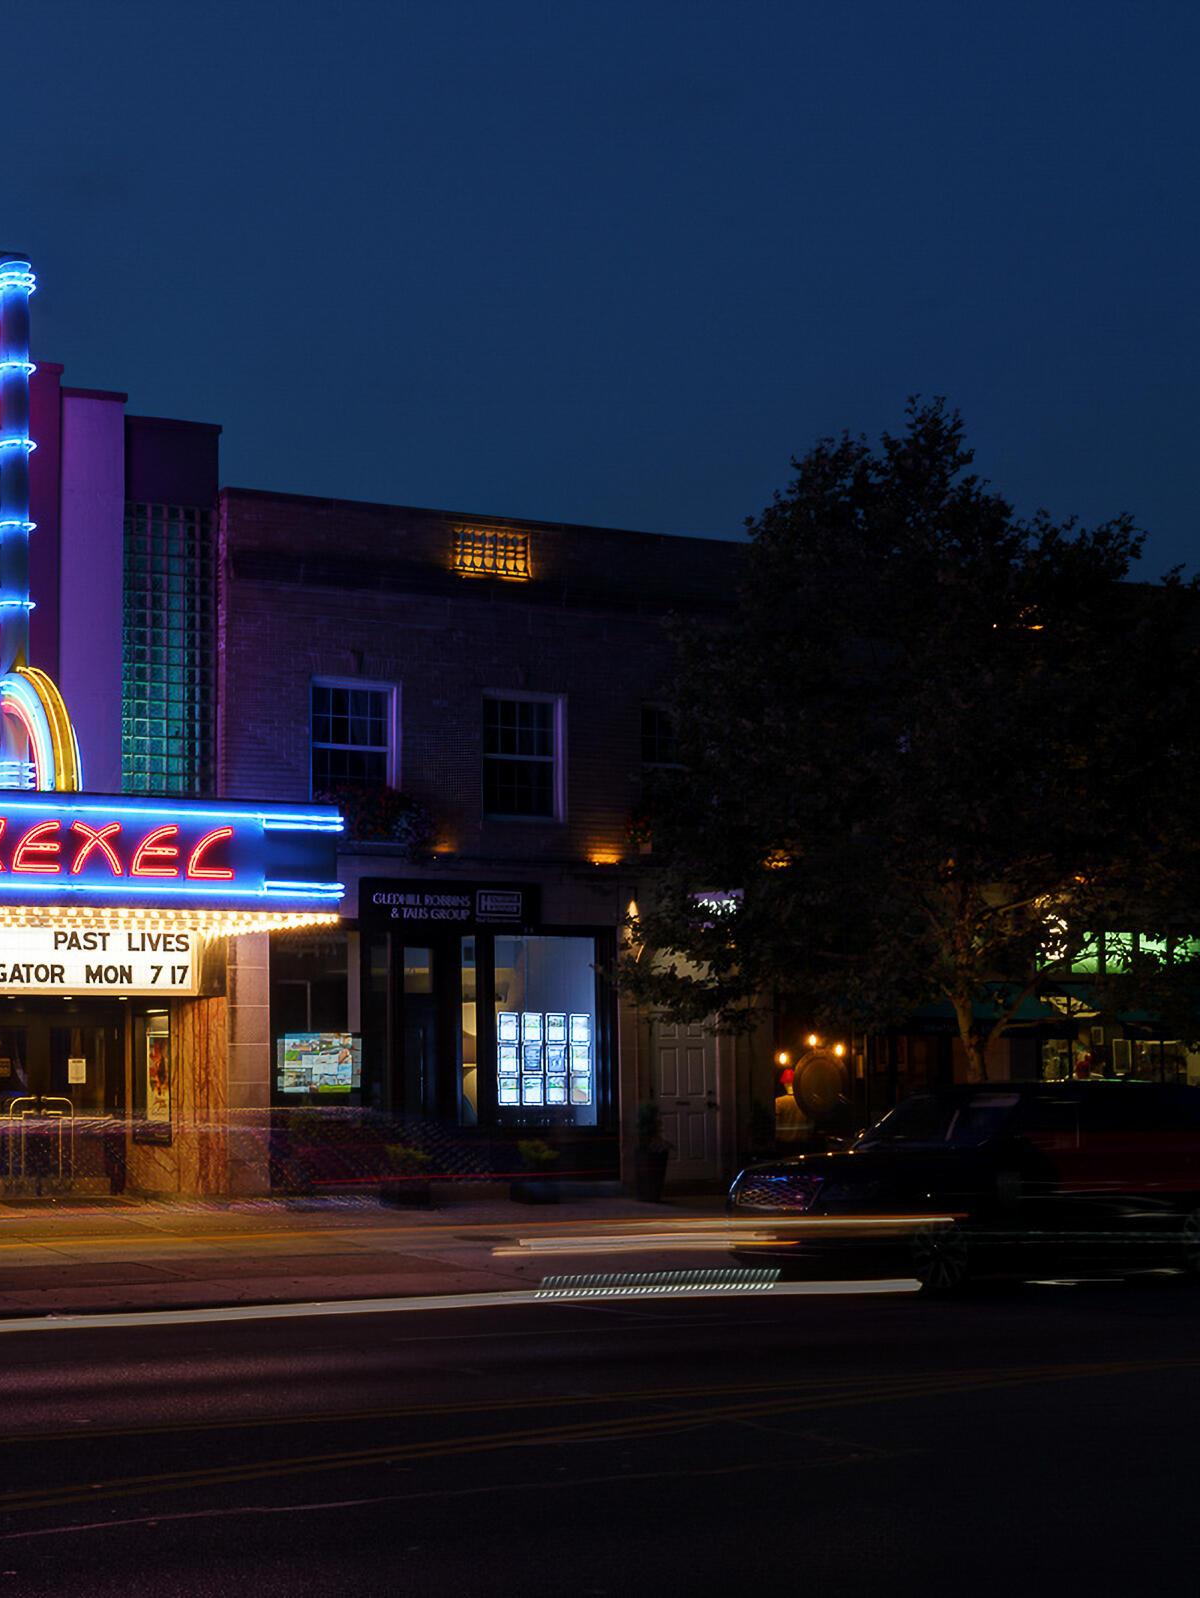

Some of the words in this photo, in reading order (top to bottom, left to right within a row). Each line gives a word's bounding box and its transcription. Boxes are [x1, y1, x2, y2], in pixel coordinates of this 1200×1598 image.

[390, 907, 400, 919] &
[430, 908, 471, 921] GROUP
[53, 930, 110, 951] PAST
[127, 932, 190, 953] LIVES
[85, 964, 133, 984] MON
